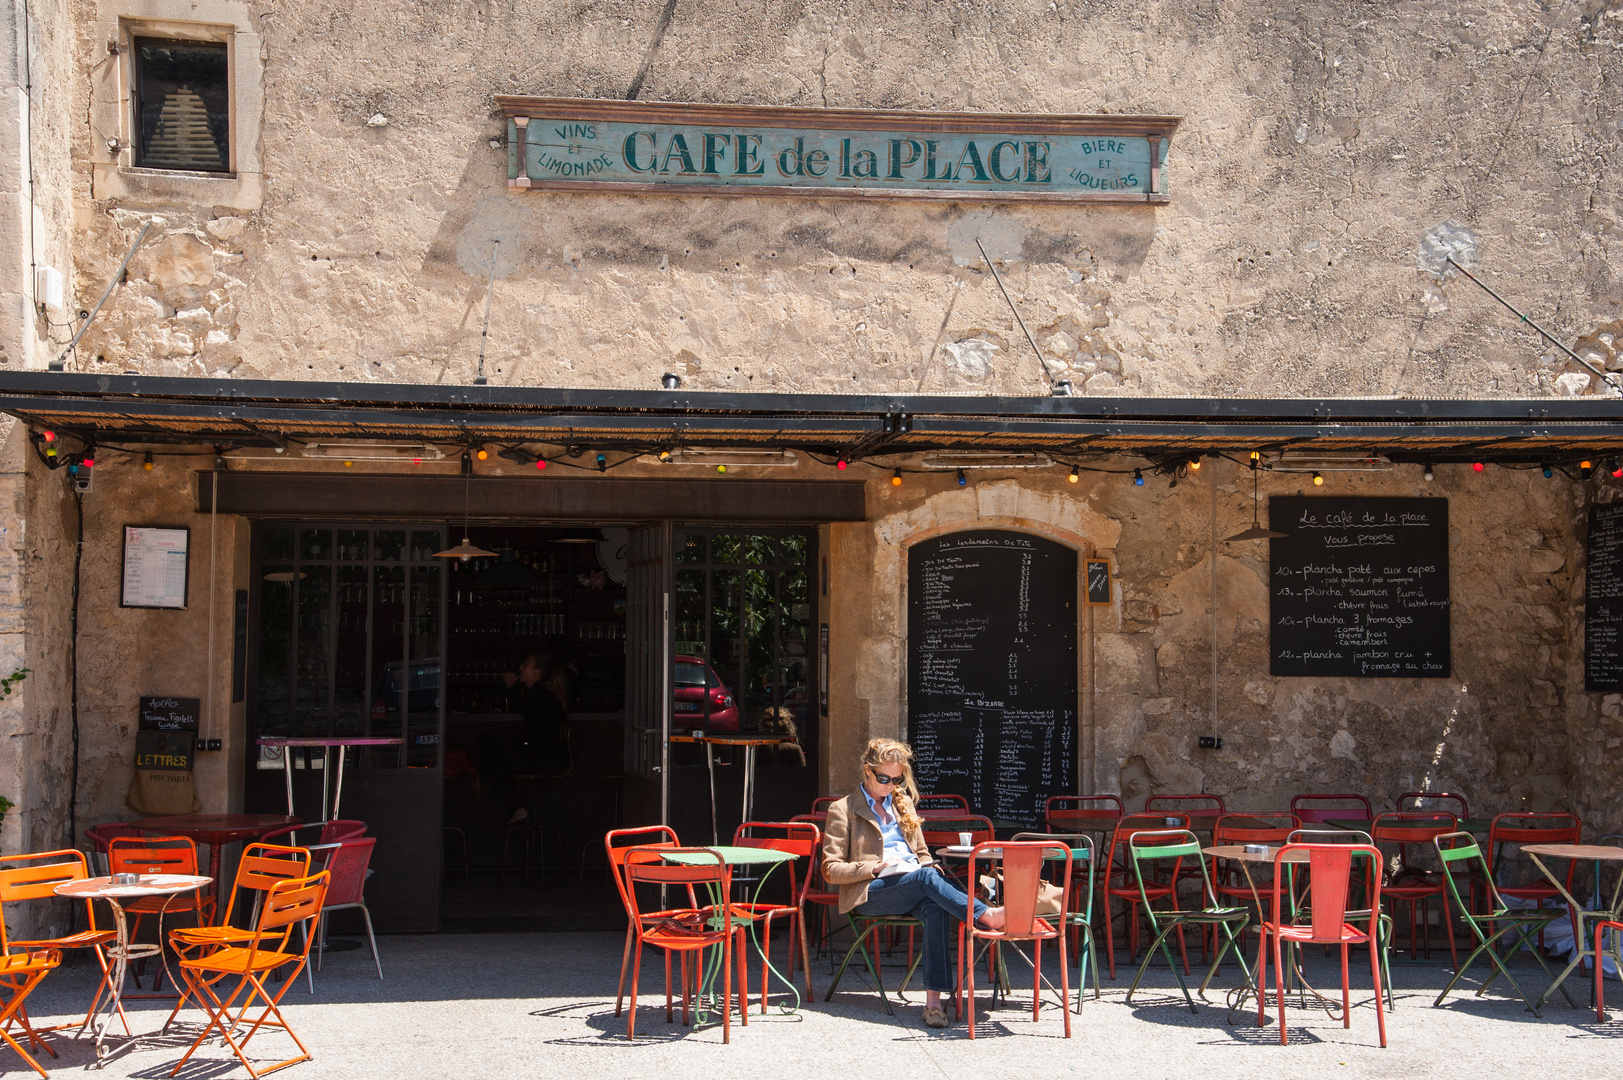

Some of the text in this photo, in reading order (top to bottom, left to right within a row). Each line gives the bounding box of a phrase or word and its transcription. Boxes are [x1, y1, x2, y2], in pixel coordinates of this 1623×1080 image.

[554, 123, 597, 140] VINS
[568, 144, 582, 154] ET
[1082, 140, 1126, 155] BIERE
[538, 152, 614, 176] LIMONADE
[622, 130, 1052, 186] CAFE de la PLACE
[1098, 159, 1112, 169] ET
[1070, 167, 1138, 190] LIQUEURS
[1300, 510, 1428, 529] Le café de la place
[1358, 534, 1394, 546] propose
[1386, 577, 1414, 586] campagne
[1350, 588, 1388, 596] saumon
[1396, 587, 1424, 602] fumé
[1370, 601, 1388, 614] frais
[1304, 614, 1345, 628] plancha
[1353, 614, 1360, 624] 3
[1366, 614, 1414, 628] fromages
[1366, 630, 1388, 642] frais
[1303, 650, 1343, 663] plancha
[1353, 651, 1390, 664] jambon
[1362, 661, 1400, 674] fromage
[1422, 662, 1444, 670] choix
[137, 754, 187, 767] LETTRES
[150, 774, 190, 783] PRETORIA
